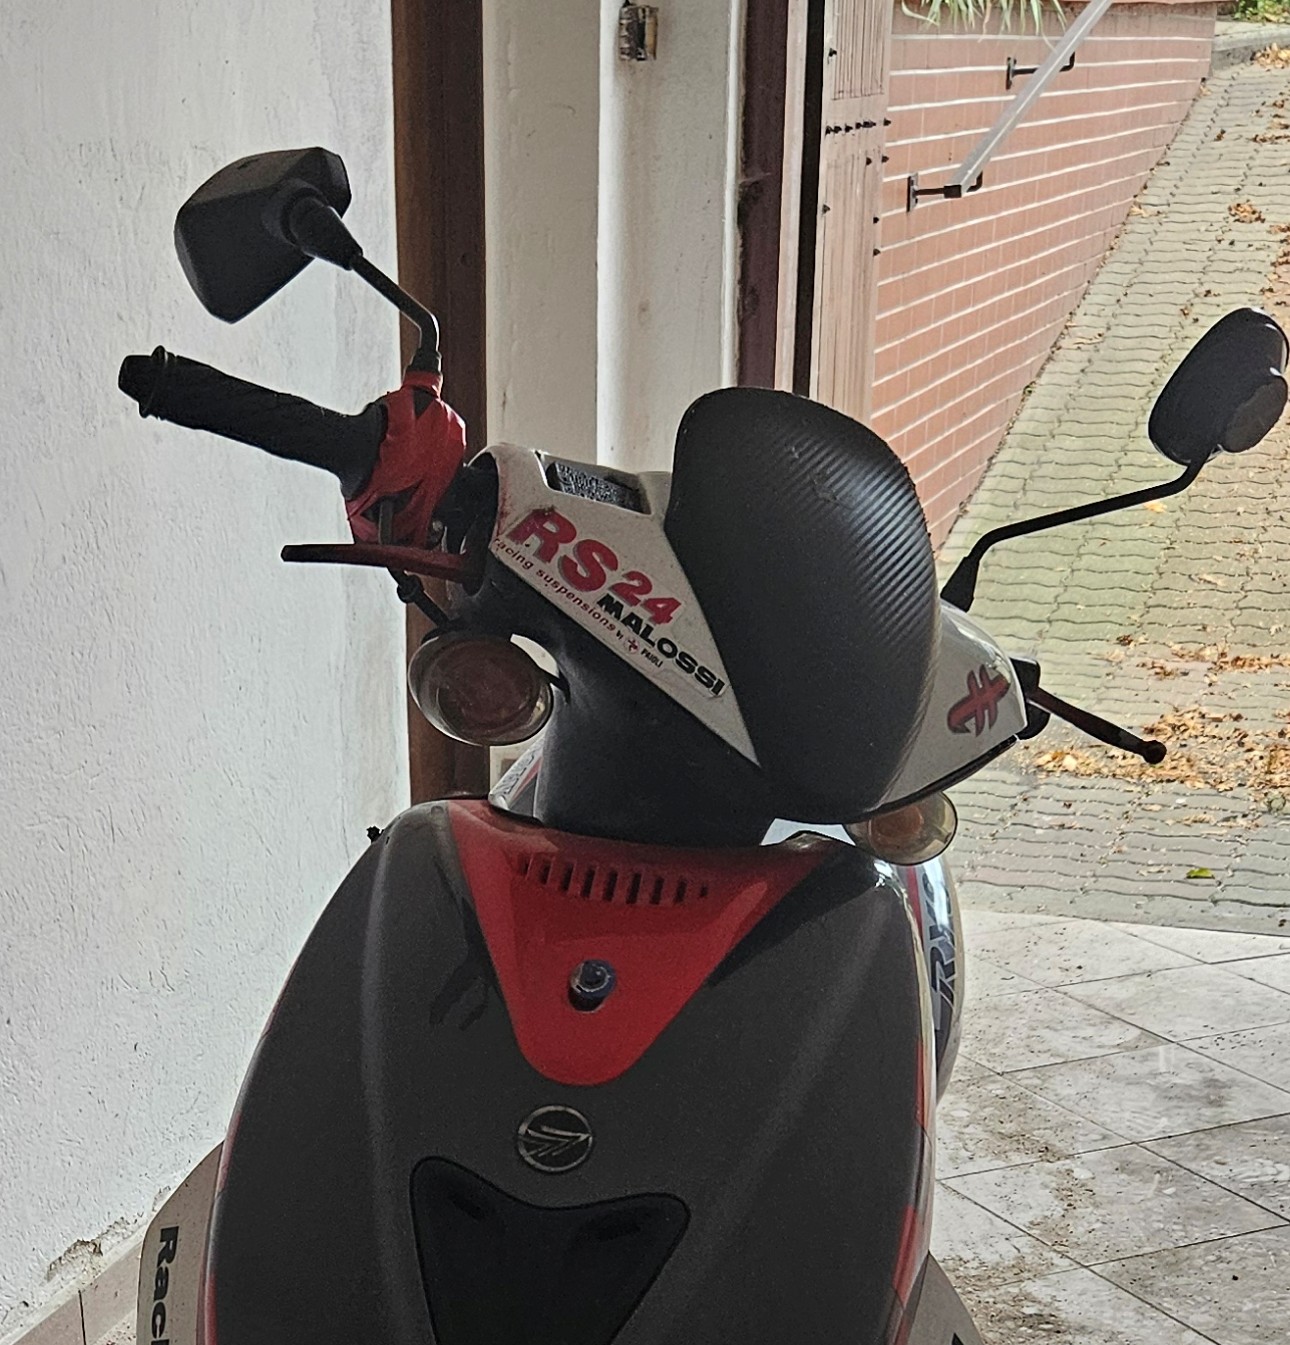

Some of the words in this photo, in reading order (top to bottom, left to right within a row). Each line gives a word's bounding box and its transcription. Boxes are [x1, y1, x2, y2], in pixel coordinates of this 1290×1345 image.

[494, 537, 533, 571] racing
[536, 568, 617, 631] suspensions
[596, 593, 726, 696] MALOSSI
